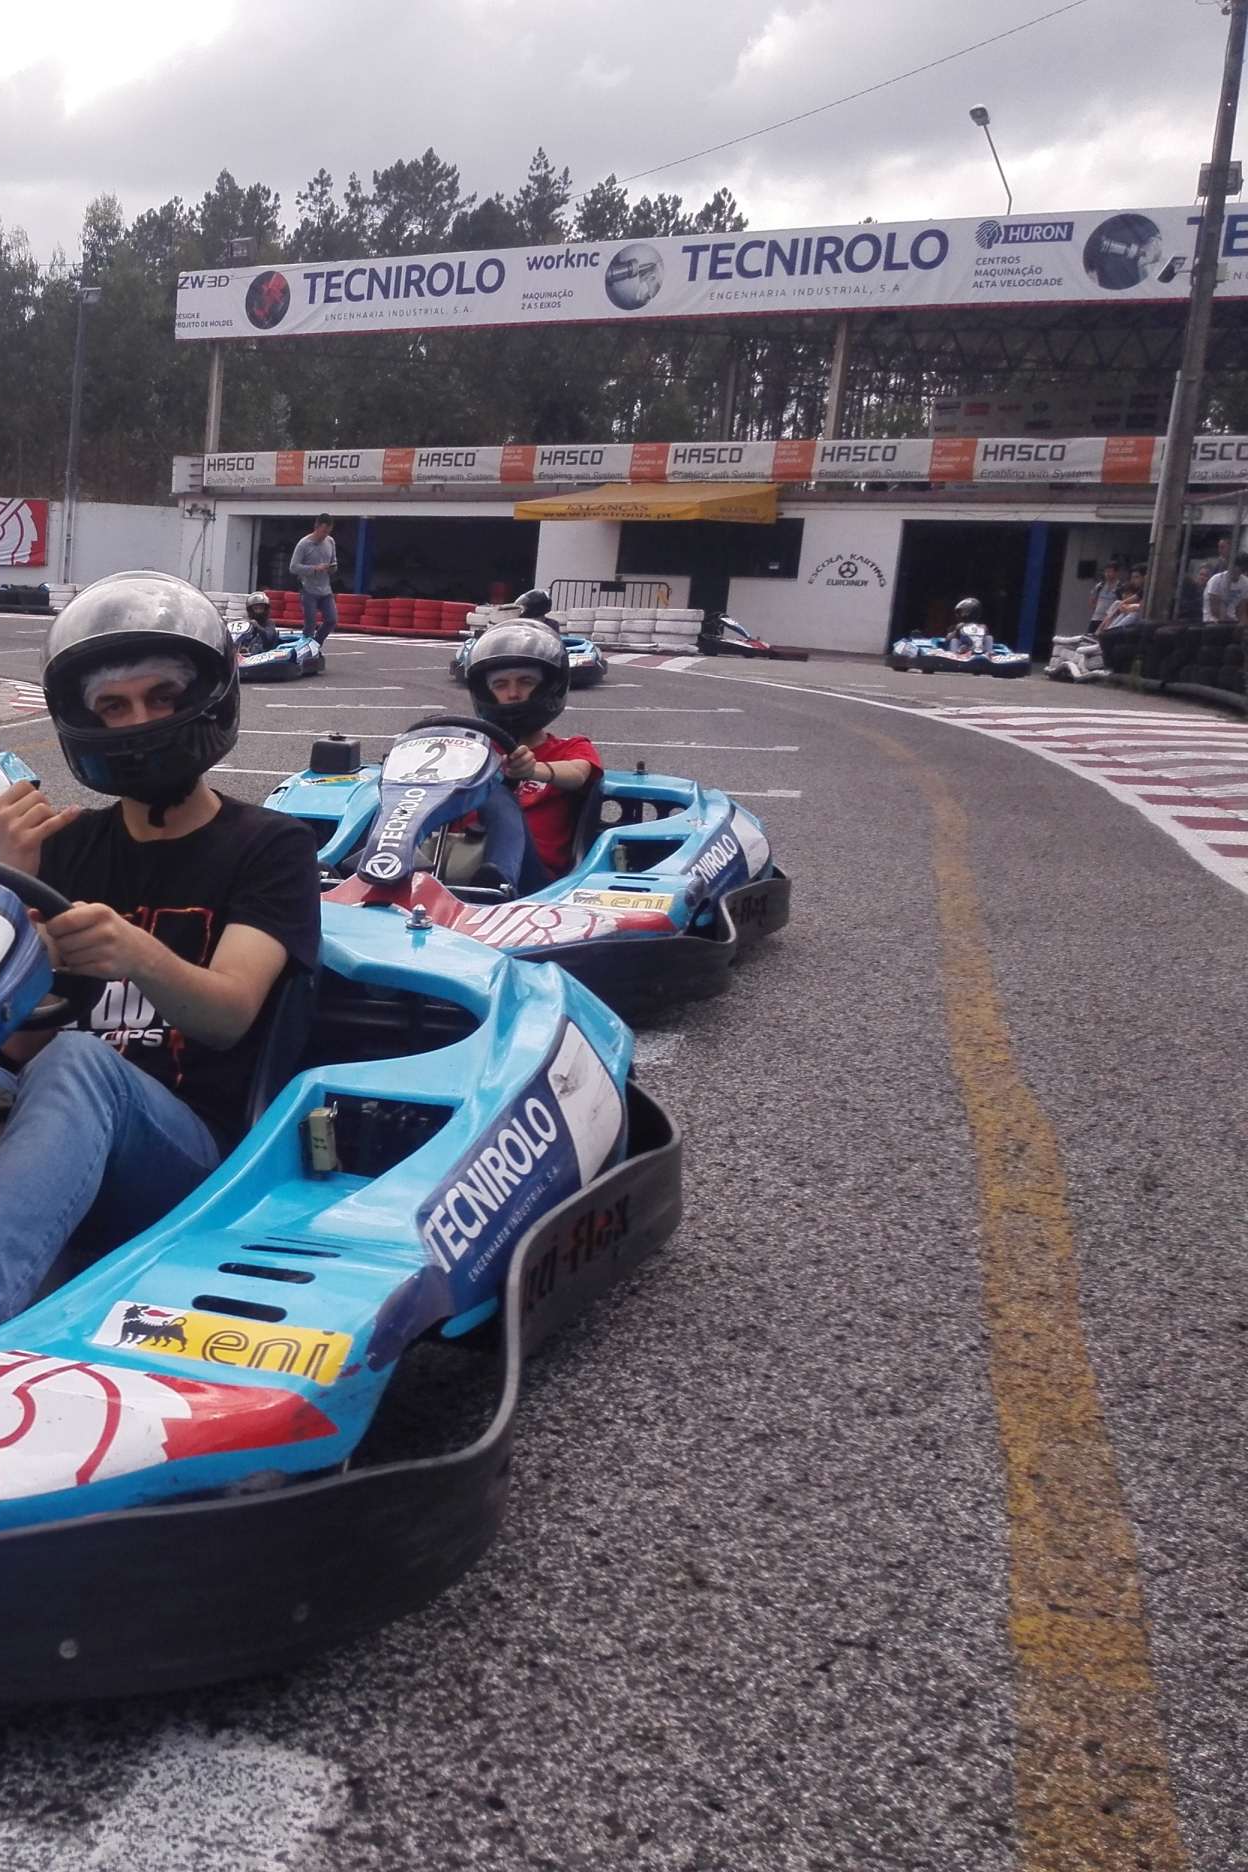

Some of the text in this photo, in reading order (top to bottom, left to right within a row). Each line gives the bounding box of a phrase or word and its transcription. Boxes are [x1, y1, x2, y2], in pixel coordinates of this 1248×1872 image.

[1008, 225, 1068, 241] HURON
[526, 248, 600, 271] worknc
[681, 229, 949, 282] TECNIROLO
[976, 256, 1021, 266] CENTROS
[974, 266, 1042, 278] MAQUINAÇÃO
[303, 258, 506, 304] TECNIROLO
[972, 277, 1063, 289] ALTA VELOCIDADE
[522, 289, 573, 300] MAQUINAÇÃO
[709, 289, 786, 300] ENGENHARIA
[325, 311, 384, 321] ENGENHARIA
[418, 453, 476, 467] HASCO
[540, 450, 603, 466] HASCO
[673, 447, 743, 464] HASCO
[821, 445, 897, 462] HASCO
[982, 444, 1066, 462] HASCO
[207, 457, 255, 471] HASCO
[308, 455, 360, 468] HASCO
[808, 554, 843, 584] ESCOLA
[415, 743, 447, 778] 2
[610, 895, 666, 909] eni
[423, 1098, 558, 1274] TECNIROLO
[202, 1329, 335, 1383] eni
